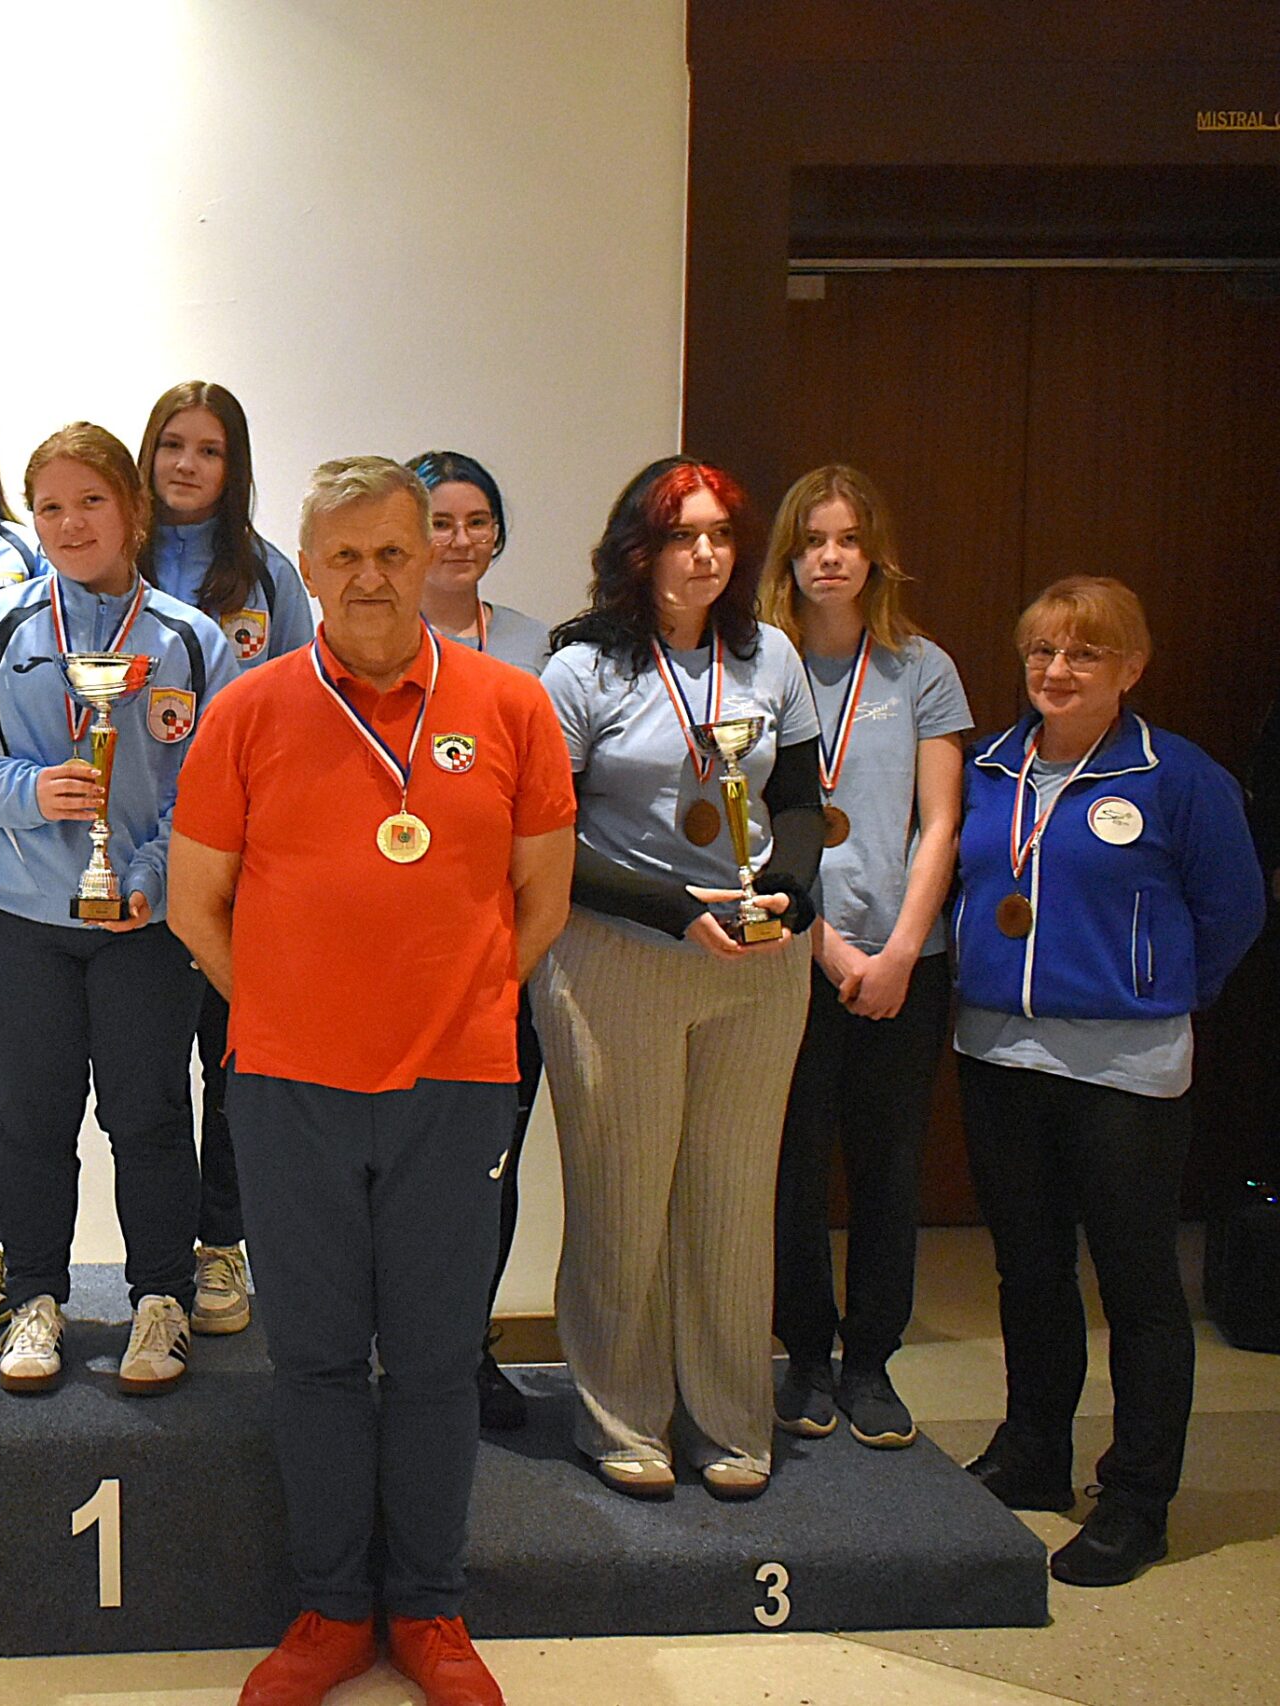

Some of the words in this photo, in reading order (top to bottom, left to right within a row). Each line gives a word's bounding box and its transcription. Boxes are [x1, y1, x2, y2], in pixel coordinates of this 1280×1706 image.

[1197, 111, 1264, 128] MISTRAL
[72, 1478, 121, 1607] 1
[754, 1562, 790, 1627] 3
